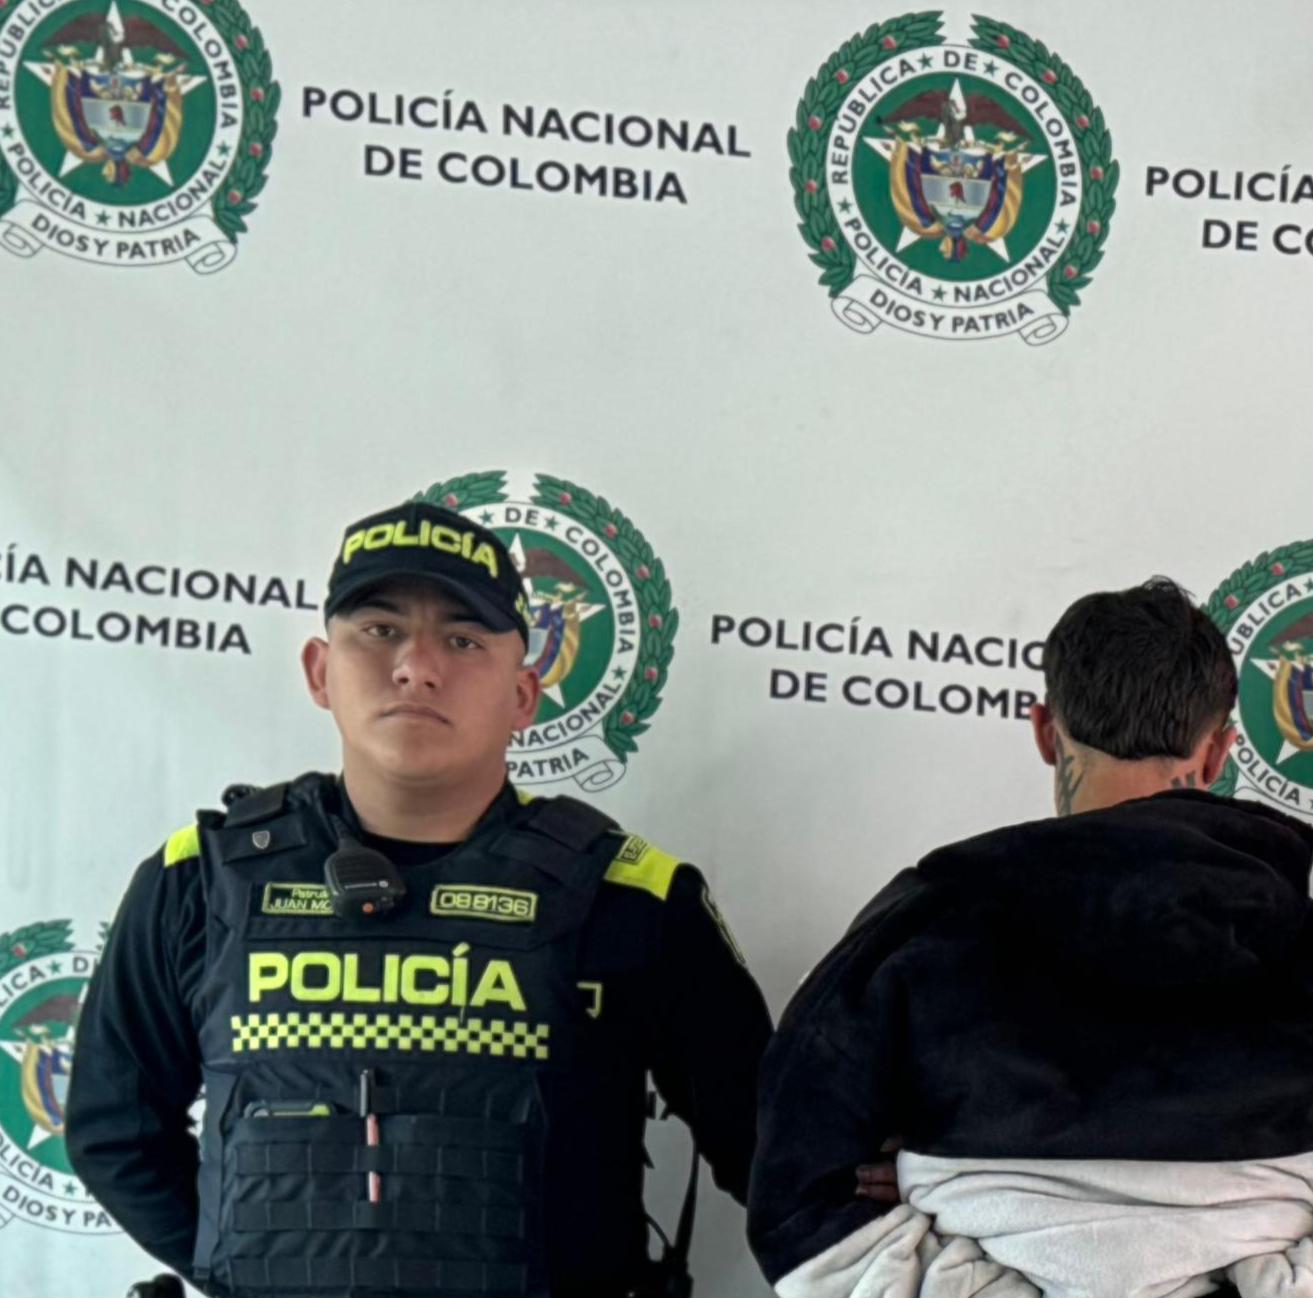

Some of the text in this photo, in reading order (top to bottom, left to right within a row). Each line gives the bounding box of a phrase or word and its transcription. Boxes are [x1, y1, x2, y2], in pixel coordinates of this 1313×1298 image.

[303, 87, 750, 157] POLICÍA NACIONAL
[943, 51, 978, 72] DE
[1005, 72, 1077, 207] COLOMBIA
[117, 162, 227, 226] NACIONAL
[365, 145, 687, 204] DE COLOMBIA
[116, 228, 200, 259] PATRIA
[1203, 219, 1258, 251] DE
[953, 239, 1064, 301] NACIONAL
[952, 303, 1034, 332] PATRIA
[343, 520, 498, 578] POLICÍA
[66, 558, 318, 610] NACIONAL
[505, 507, 636, 653] DE COLOMBIA
[1, 604, 251, 654] COLOMBIA
[711, 615, 1046, 671] POLICÍA NACIO
[770, 669, 1037, 720] DE COLOMB
[439, 891, 530, 917] 088136
[249, 942, 526, 1011] POLICÍA
